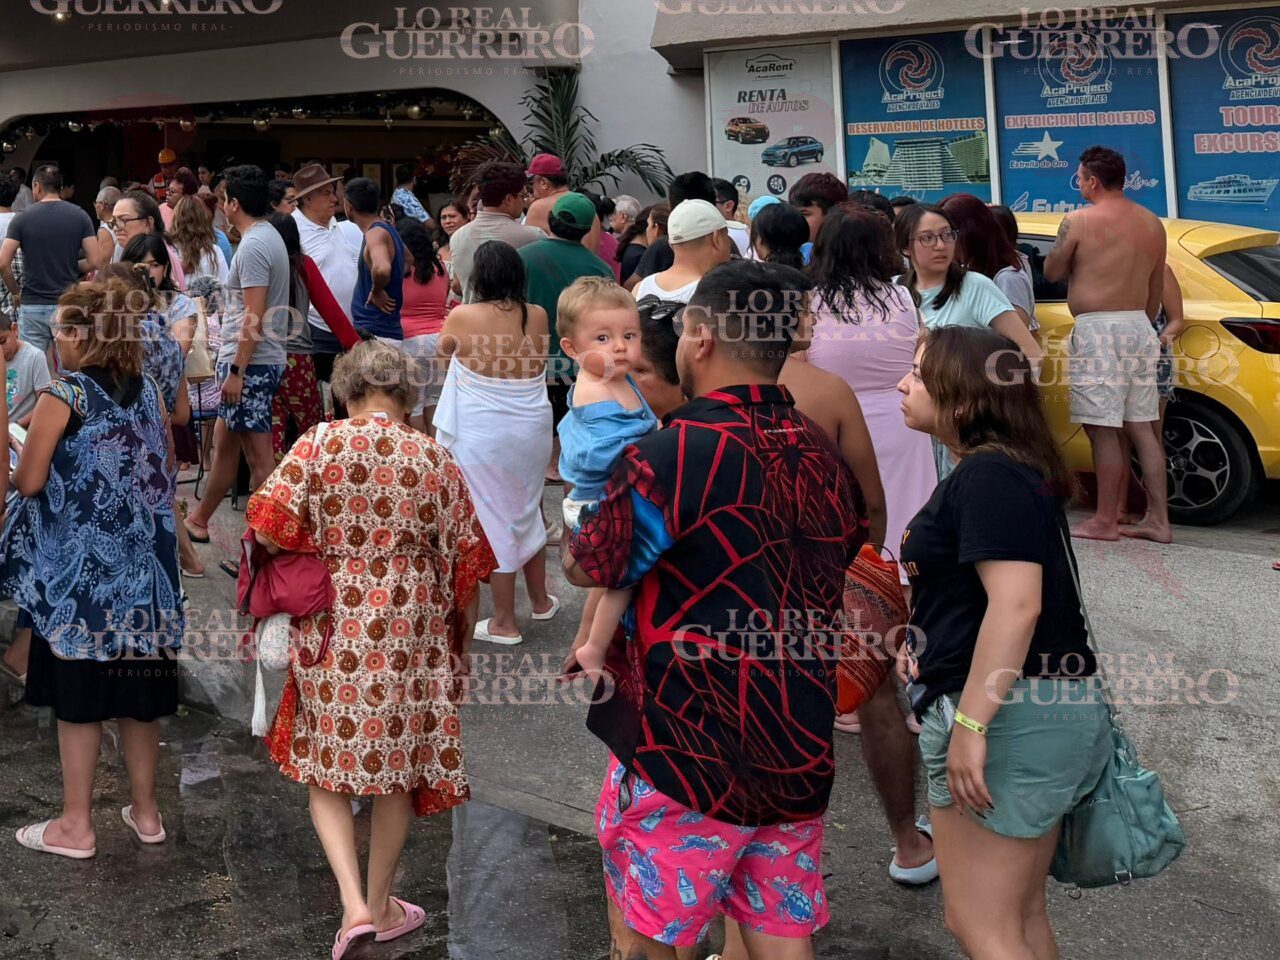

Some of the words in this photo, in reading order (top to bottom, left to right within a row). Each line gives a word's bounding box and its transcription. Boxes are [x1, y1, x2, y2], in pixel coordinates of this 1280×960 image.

[747, 62, 794, 73] AcaRent
[737, 88, 787, 103] RENTA
[882, 88, 944, 103] AcaProject
[1041, 82, 1112, 97] AcaProject
[1230, 89, 1263, 100] AGENCIA
[748, 102, 765, 114] DE
[766, 99, 809, 113] AUTOS
[887, 102, 912, 112] AGENCIA
[919, 100, 940, 110] VIAJES
[1047, 97, 1074, 107] AGENCIA
[1084, 94, 1107, 105] VIAJES
[848, 120, 920, 135] RESERVACION
[921, 119, 937, 132] DE
[937, 117, 985, 131] HOTELES
[1005, 113, 1078, 129] EXPEDICION
[1079, 112, 1096, 126] DE
[1097, 110, 1155, 125] BOLETOS
[1009, 159, 1039, 168] Estrella
[1040, 160, 1051, 168] de
[1052, 160, 1068, 168] Oro
